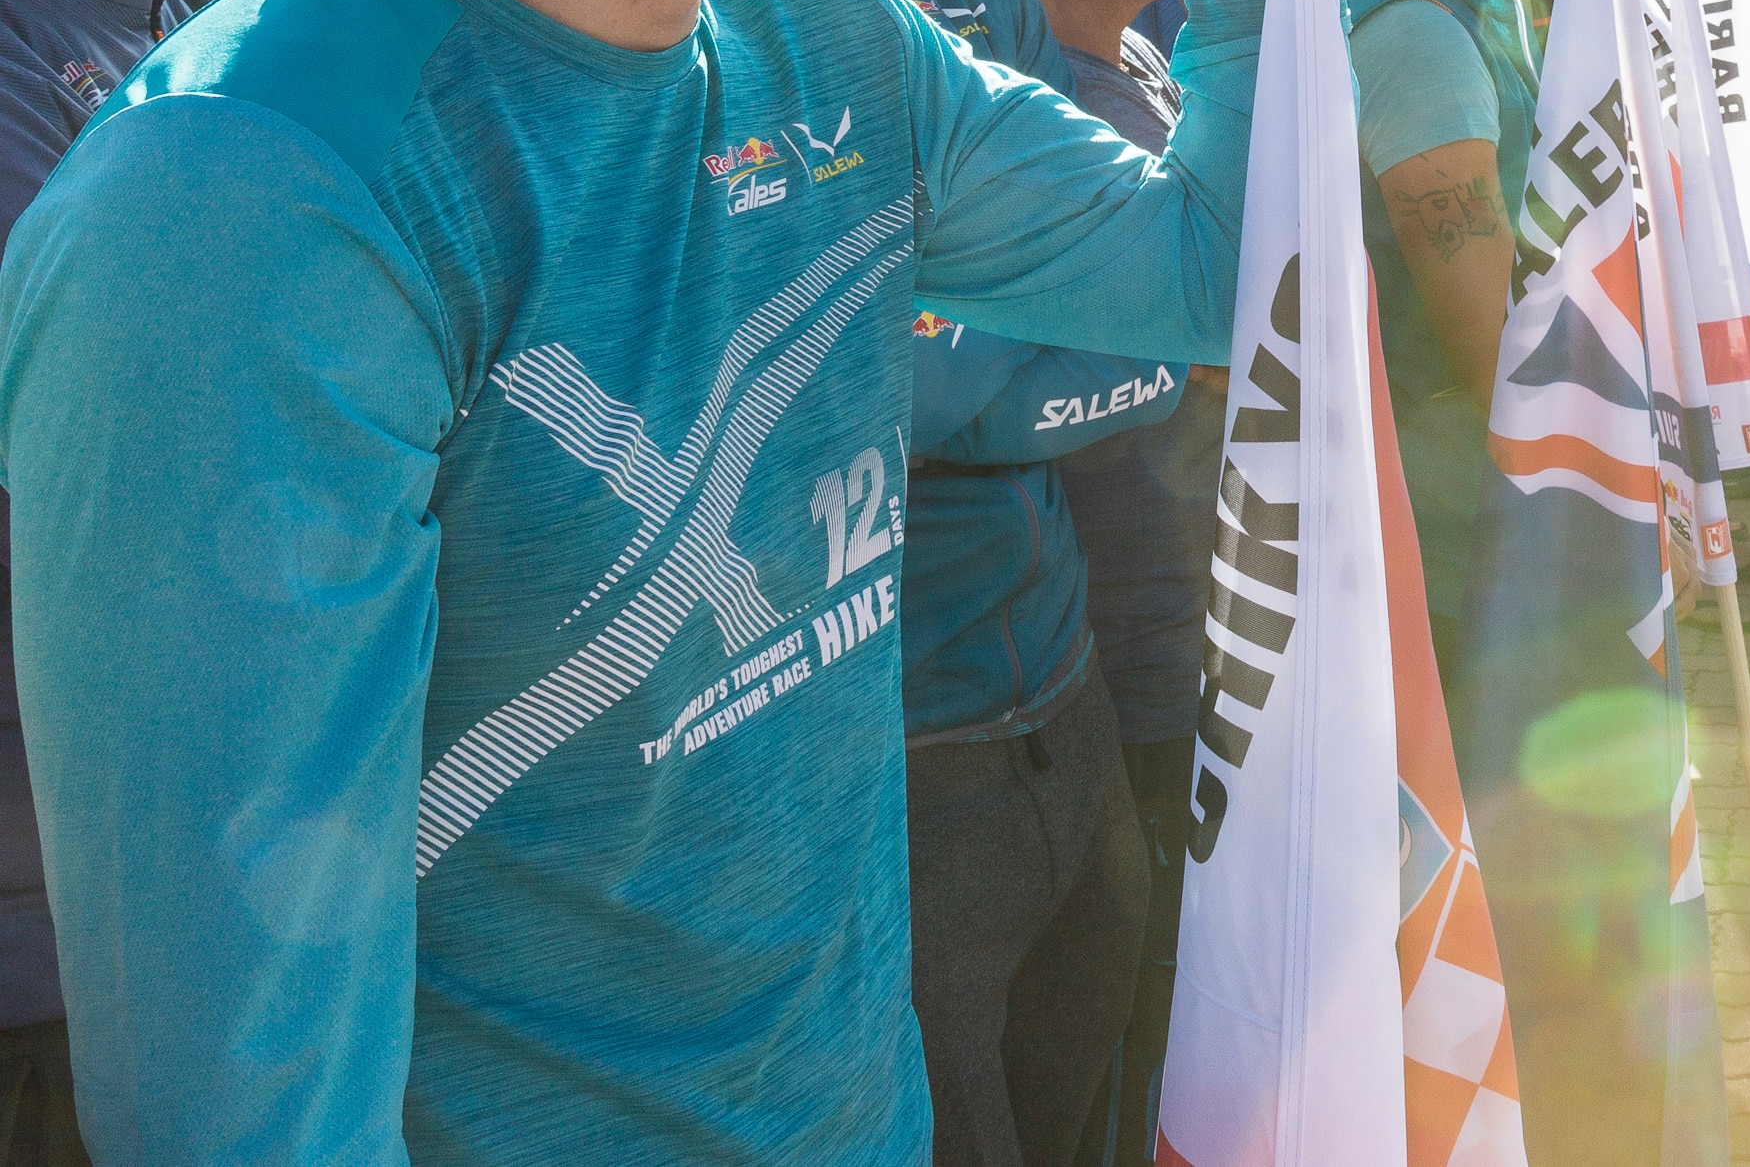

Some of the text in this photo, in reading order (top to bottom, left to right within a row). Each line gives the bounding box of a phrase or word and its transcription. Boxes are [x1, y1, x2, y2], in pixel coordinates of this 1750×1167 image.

[814, 151, 865, 182] SALEWA
[1034, 365, 1175, 431] SALEWA
[810, 446, 892, 591] 12
[888, 494, 905, 547] DAYS
[812, 575, 897, 668] HIKE
[639, 629, 805, 765] THE WORLD'S TOUGHEST
[683, 658, 812, 757] ADVENTURE RACE
